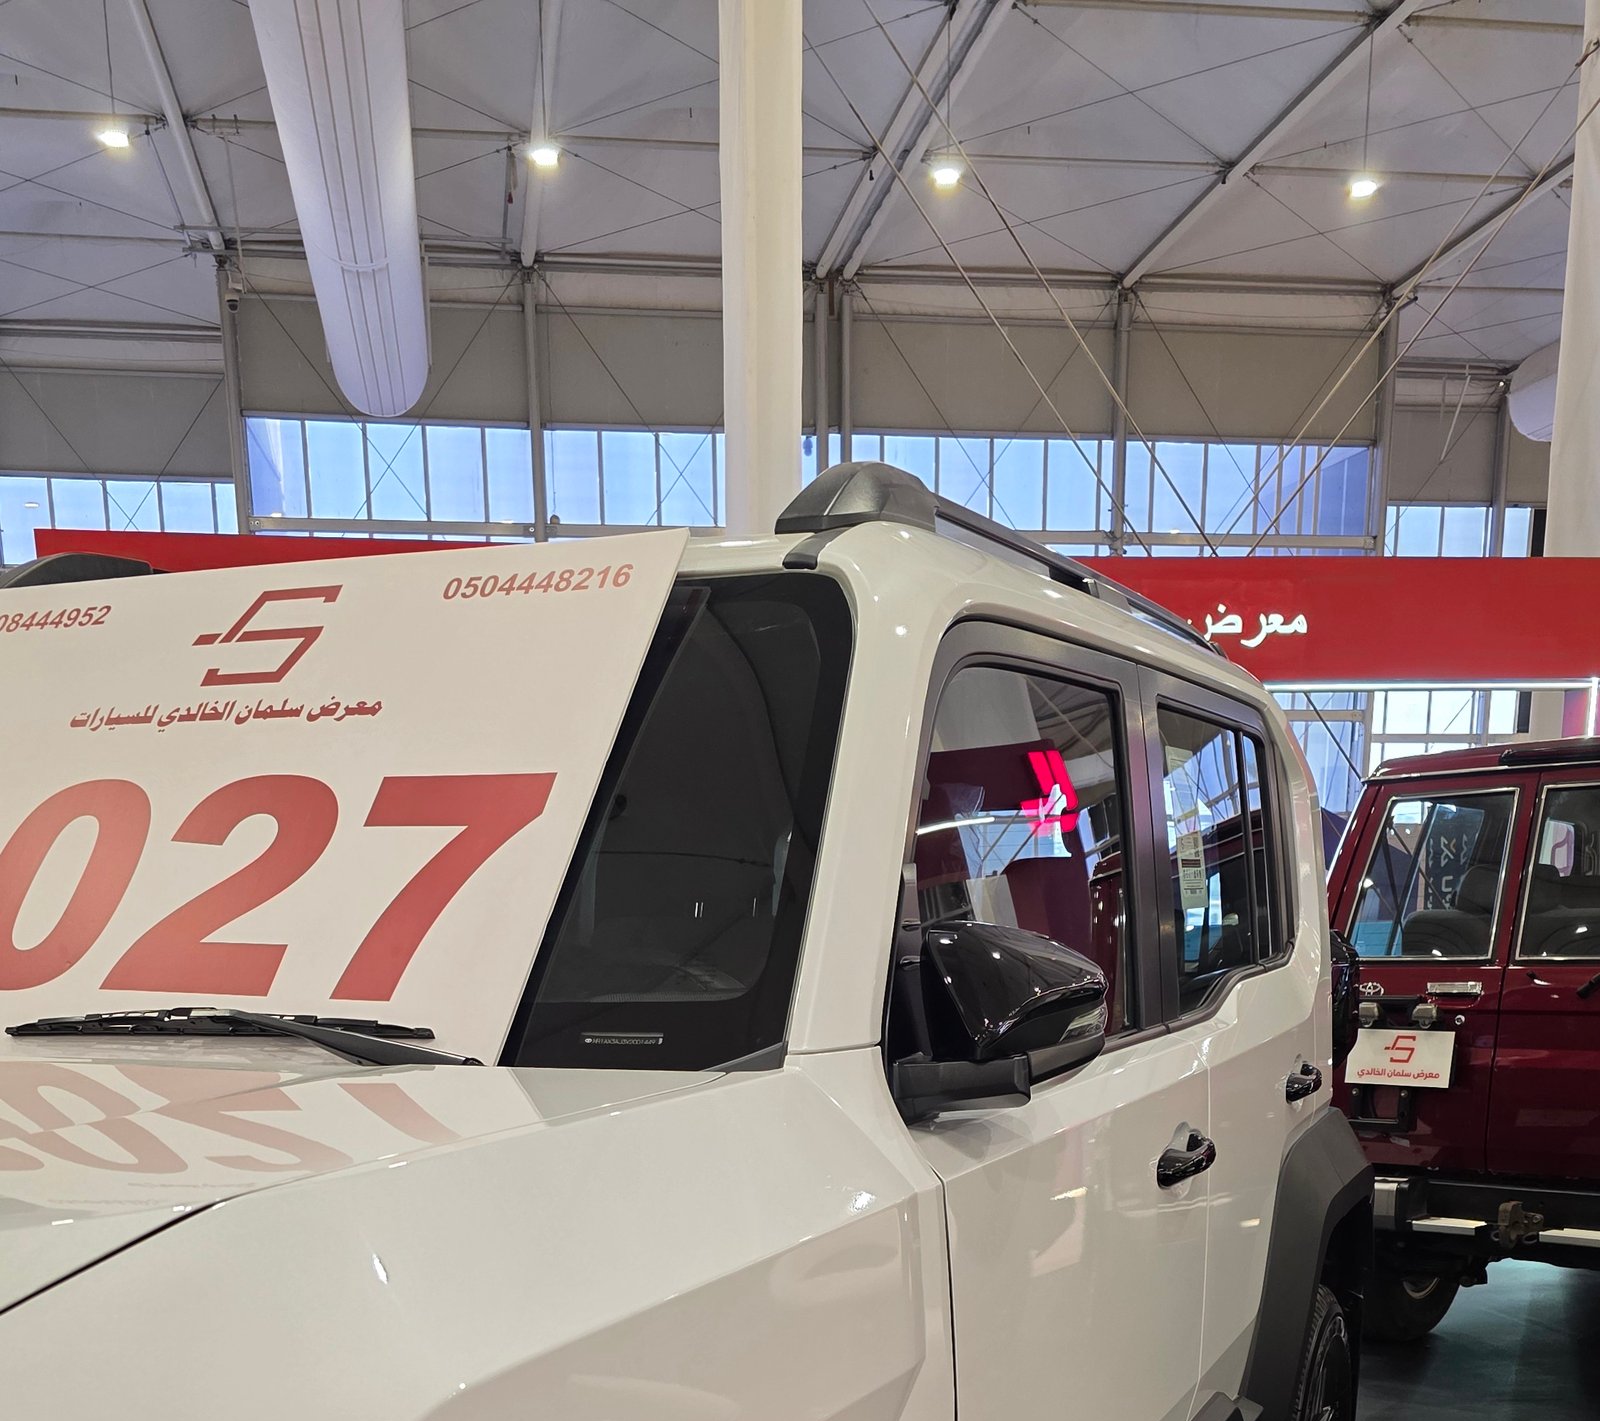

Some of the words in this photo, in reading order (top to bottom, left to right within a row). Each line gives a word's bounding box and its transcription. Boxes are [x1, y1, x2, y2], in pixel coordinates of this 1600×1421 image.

[443, 563, 634, 600] 0504448216
[1203, 603, 1308, 648] معرض
[69, 703, 160, 732] للسيارات
[156, 699, 238, 733] الخالدي
[234, 698, 305, 726] سلمان
[306, 695, 384, 723] معرض
[0, 772, 558, 1002] 027
[1356, 1067, 1387, 1079] الخالدي
[1387, 1069, 1412, 1079] سلمان
[1412, 1069, 1441, 1081] معرض
